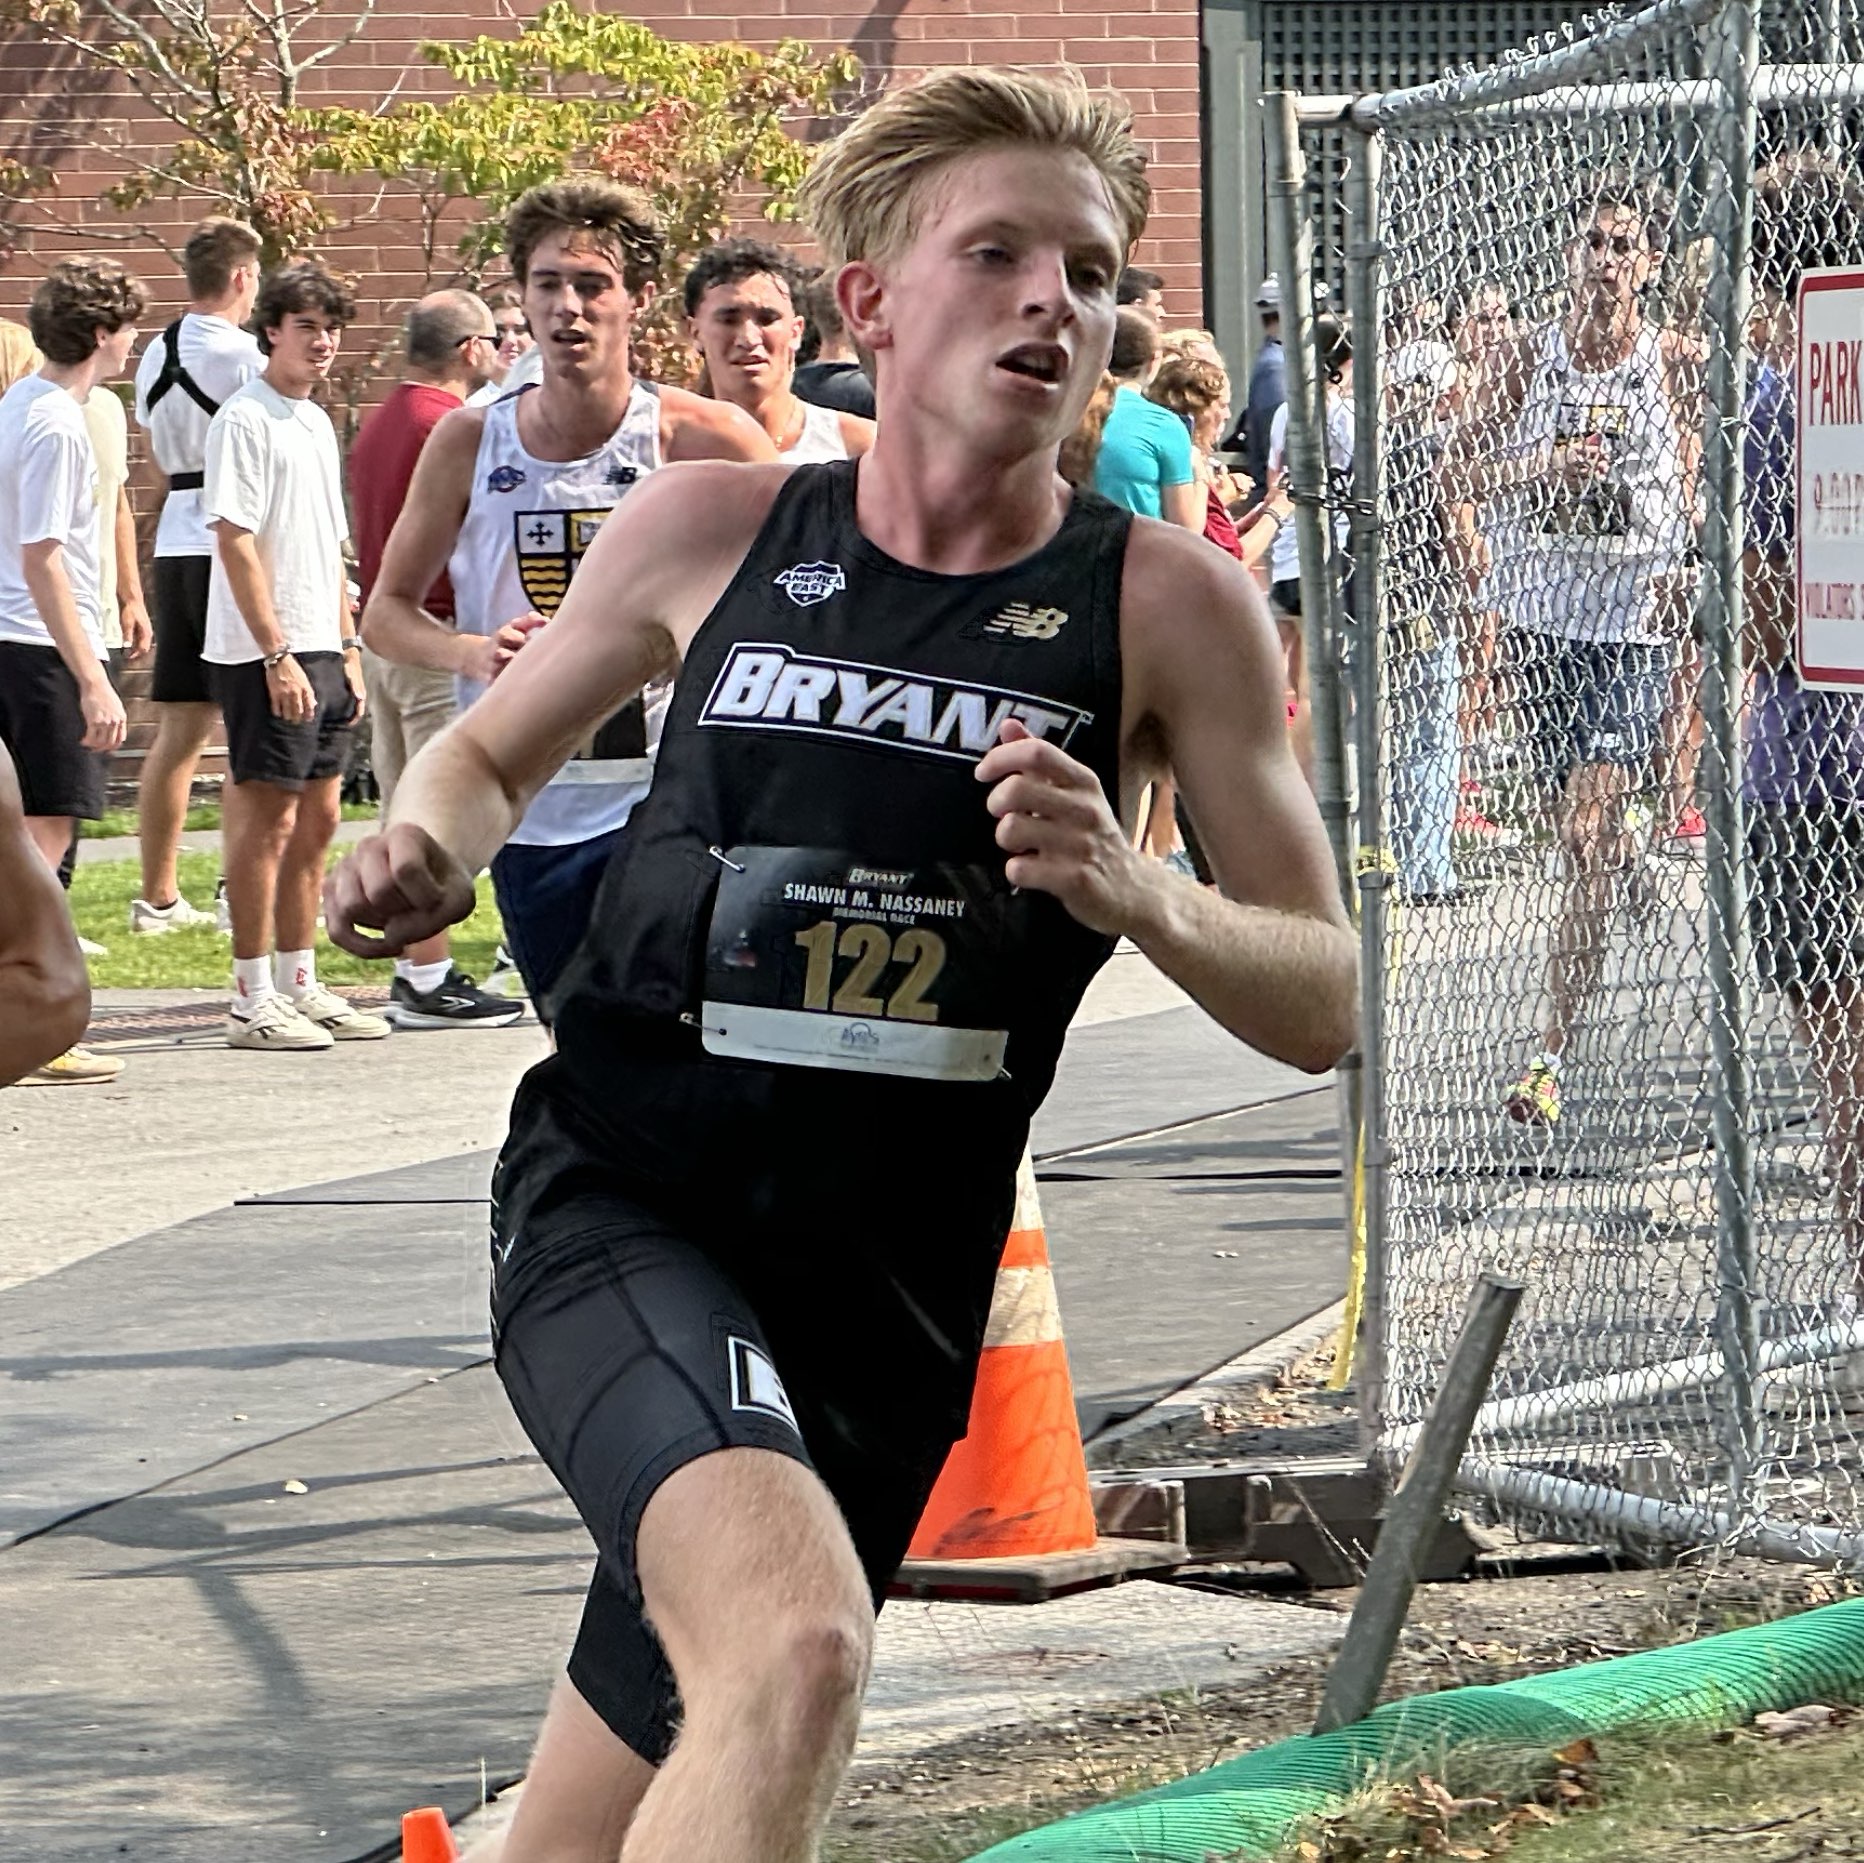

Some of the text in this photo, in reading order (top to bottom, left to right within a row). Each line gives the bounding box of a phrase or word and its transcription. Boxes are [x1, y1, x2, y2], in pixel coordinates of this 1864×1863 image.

[710, 652, 1071, 752] BRYANT
[784, 883, 966, 917] SHAWN M. NASSANEY
[795, 921, 946, 1022] 122
